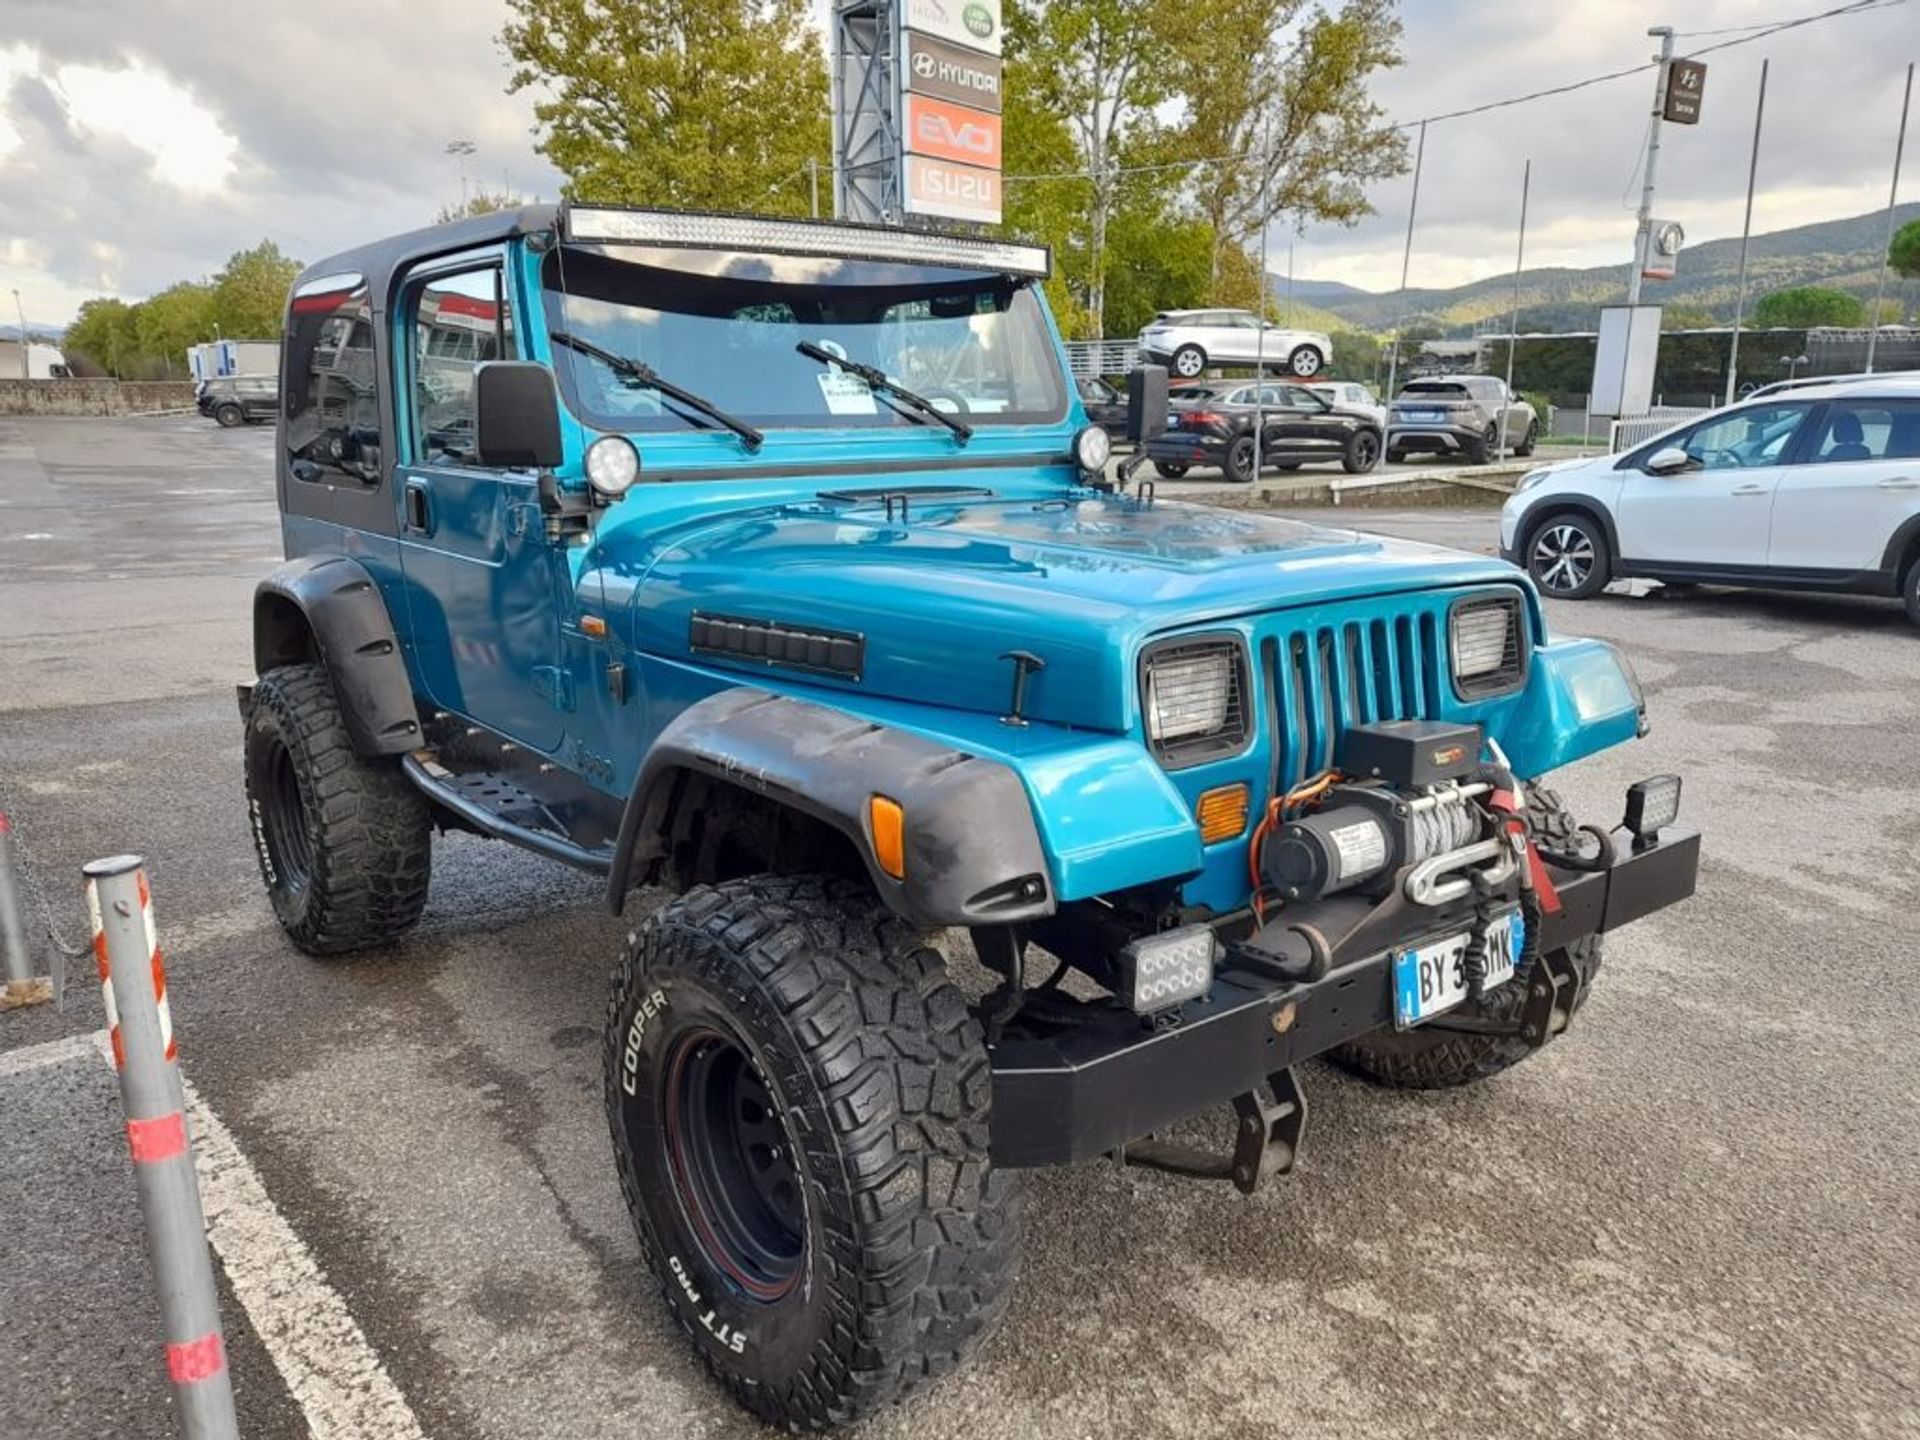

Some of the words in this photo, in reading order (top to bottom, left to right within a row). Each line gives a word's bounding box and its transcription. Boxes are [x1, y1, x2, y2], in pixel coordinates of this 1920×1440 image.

[938, 61, 998, 94] HYUNDAI
[918, 113, 993, 154] EVO
[921, 168, 991, 201] ISUZU
[1420, 954, 1445, 1003] BY
[1452, 928, 1512, 989] 3MK
[622, 989, 668, 1096] COOPER
[669, 1256, 700, 1303] PRO
[699, 1310, 747, 1353] STT
